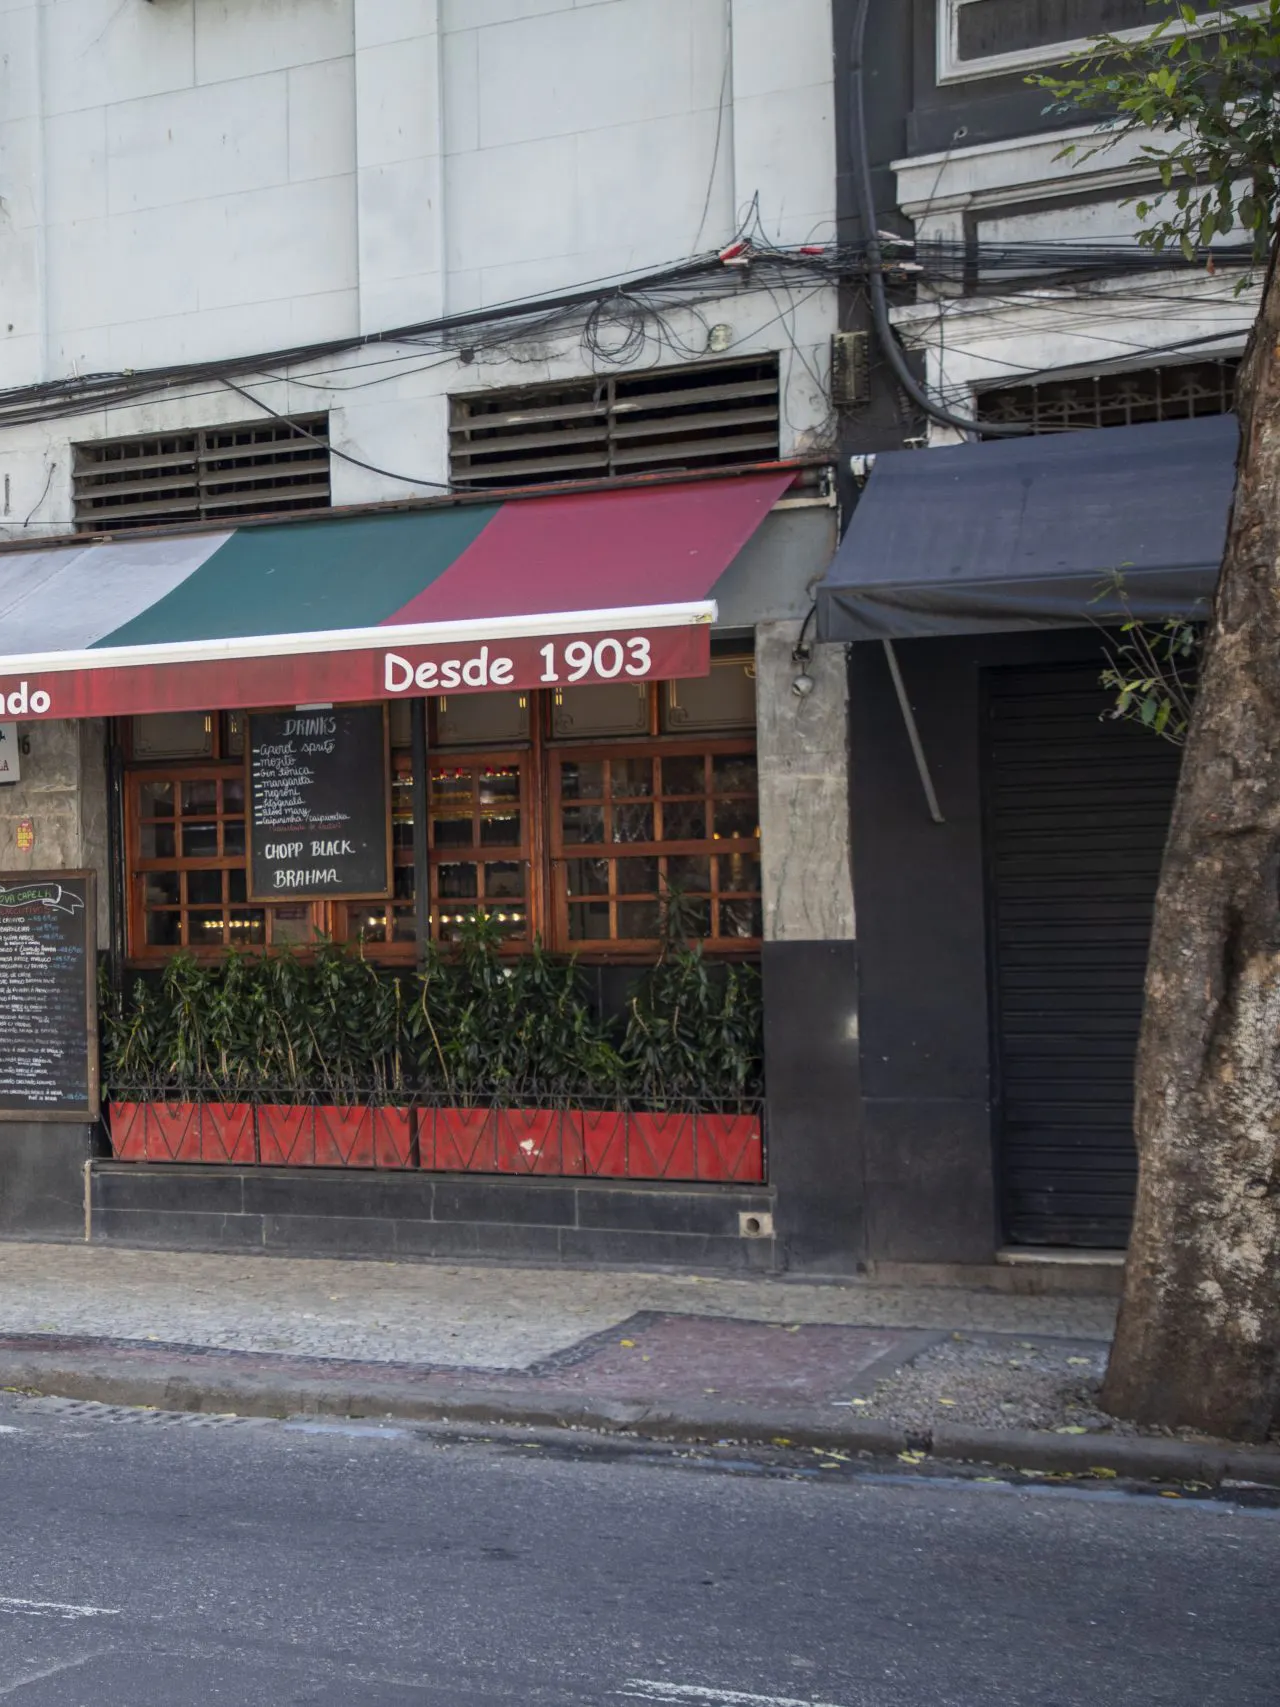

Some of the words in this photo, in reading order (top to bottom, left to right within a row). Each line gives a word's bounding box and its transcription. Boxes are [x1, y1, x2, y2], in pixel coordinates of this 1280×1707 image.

[384, 645, 514, 692] Desde
[540, 637, 652, 682] 1903
[283, 717, 337, 736] DRINKS
[265, 842, 304, 860] CHOPP
[311, 840, 356, 857] BLACK
[273, 868, 342, 888] BRAHMA
